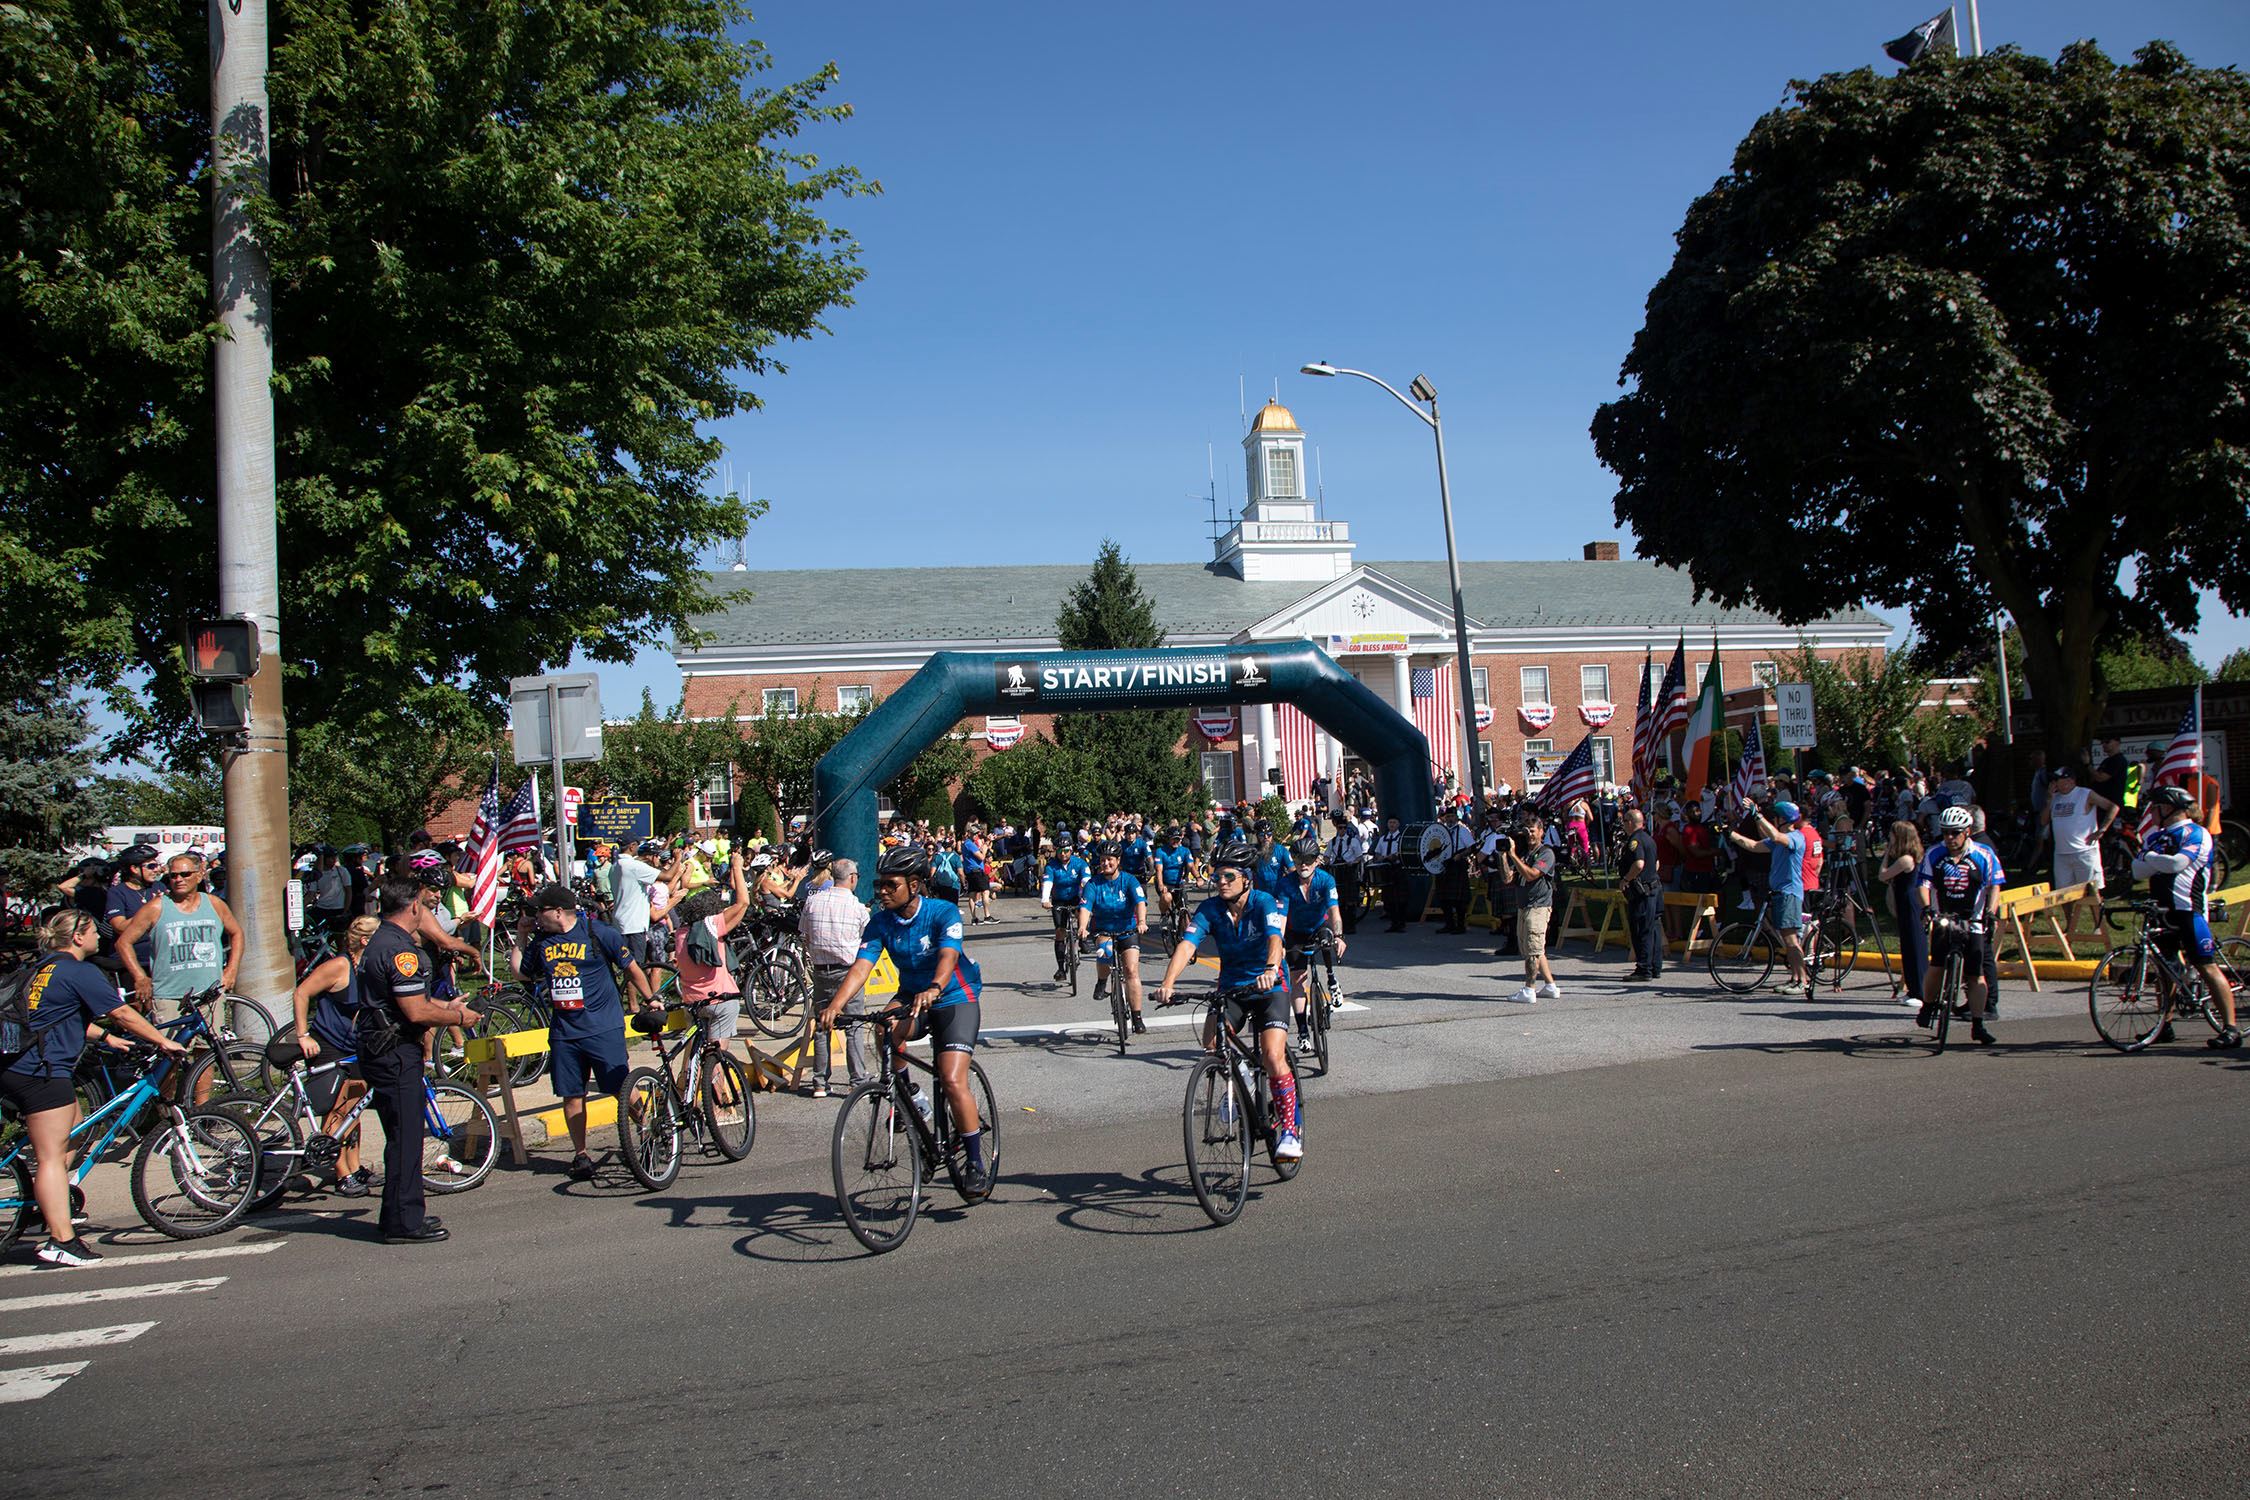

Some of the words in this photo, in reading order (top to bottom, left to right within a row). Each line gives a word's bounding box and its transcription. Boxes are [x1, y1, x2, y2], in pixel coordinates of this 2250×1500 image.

[1348, 643, 1361, 652] GOD
[1362, 643, 1380, 652] BLESS
[1381, 643, 1408, 652] AMERICA
[1043, 662, 1226, 690] START/FINISH
[1788, 690, 1801, 703] NO
[1785, 708, 1807, 720] THRU
[2205, 699, 2250, 717] HAL
[1781, 724, 1813, 738] TRAFFIC
[166, 925, 217, 946] MONT
[169, 943, 199, 964] AUK
[544, 942, 587, 962] SCPOA
[552, 977, 582, 989] 1400
